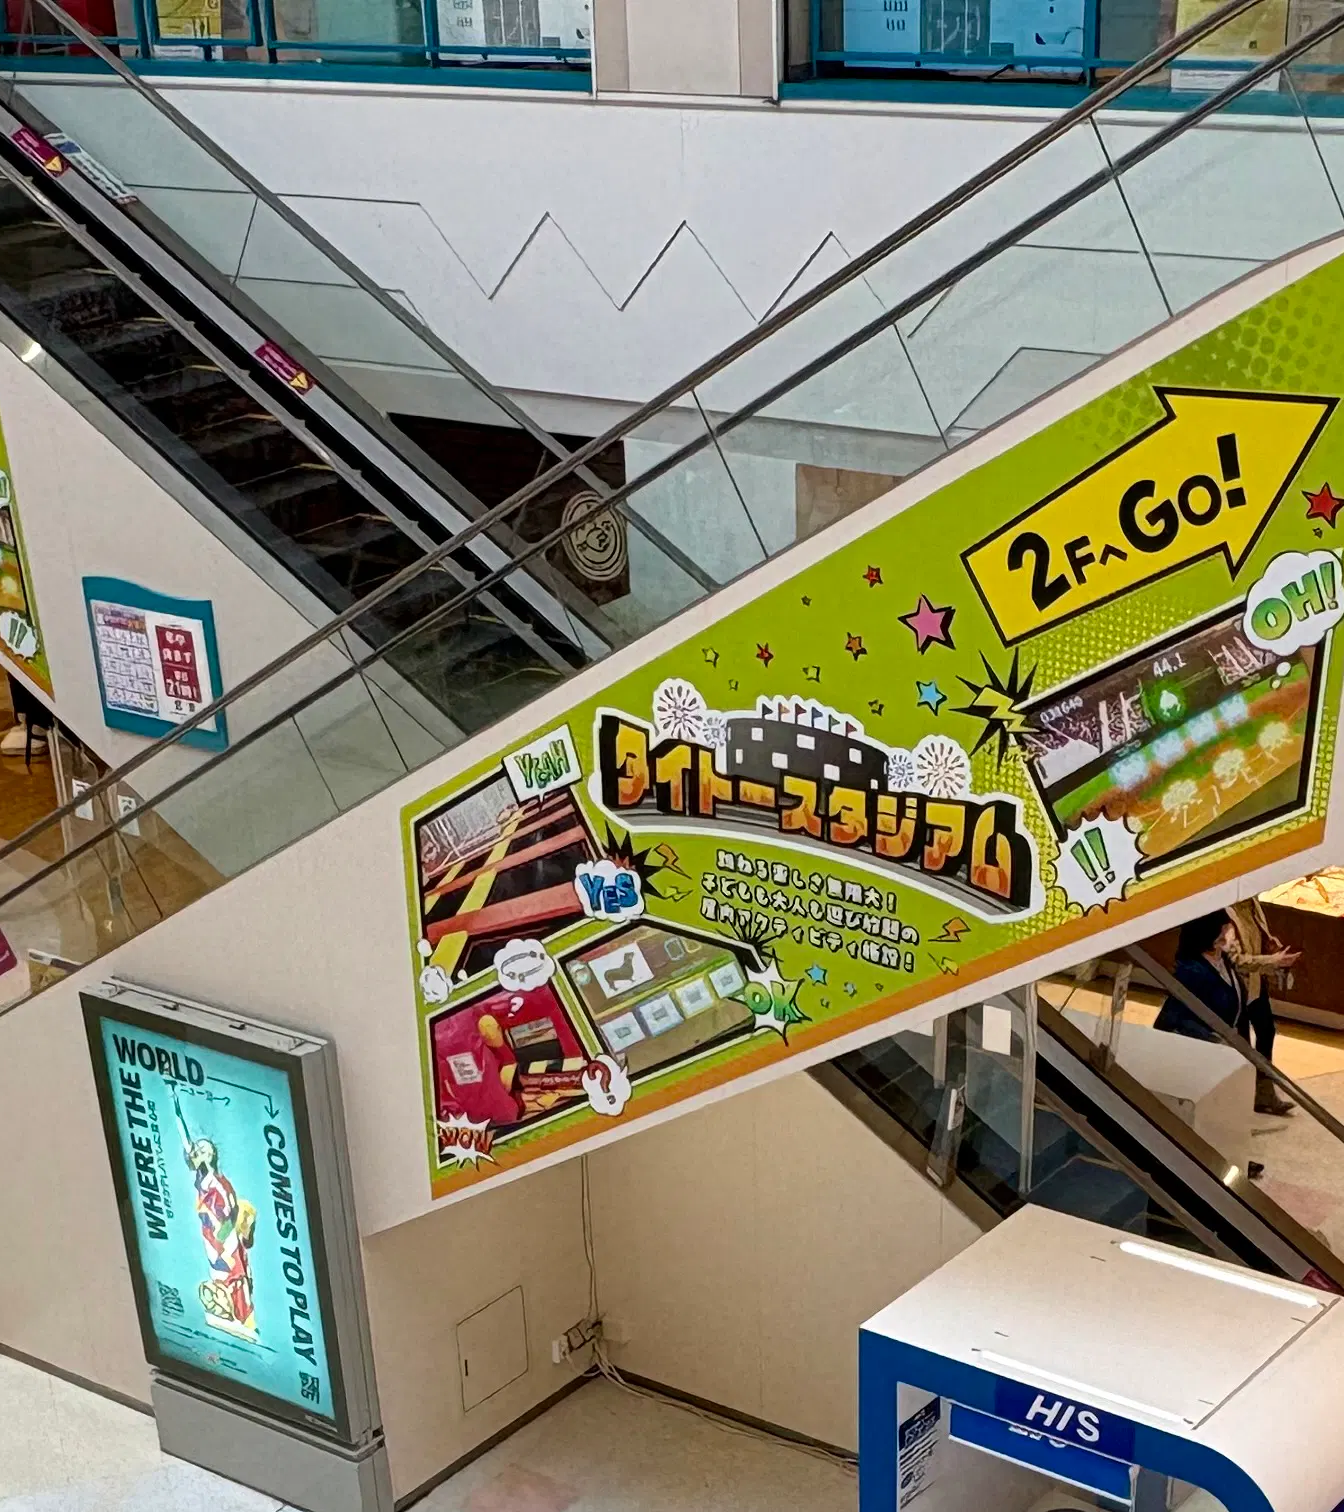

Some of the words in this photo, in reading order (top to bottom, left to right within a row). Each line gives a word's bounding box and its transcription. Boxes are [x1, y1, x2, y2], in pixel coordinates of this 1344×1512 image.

[1251, 561, 1340, 641] OH!
[514, 739, 572, 791] YEAH
[608, 717, 1020, 903] タイトースタジアム
[579, 871, 639, 914] YES
[745, 983, 800, 1025] OK
[112, 1034, 204, 1086] WORLD
[119, 1067, 150, 1129] THE
[439, 1127, 496, 1155] WOW
[130, 1132, 169, 1240] WHERE
[263, 1124, 298, 1243] COMES
[281, 1246, 304, 1286] TO
[286, 1293, 318, 1367] PLAY
[1026, 1394, 1100, 1442] HIS
